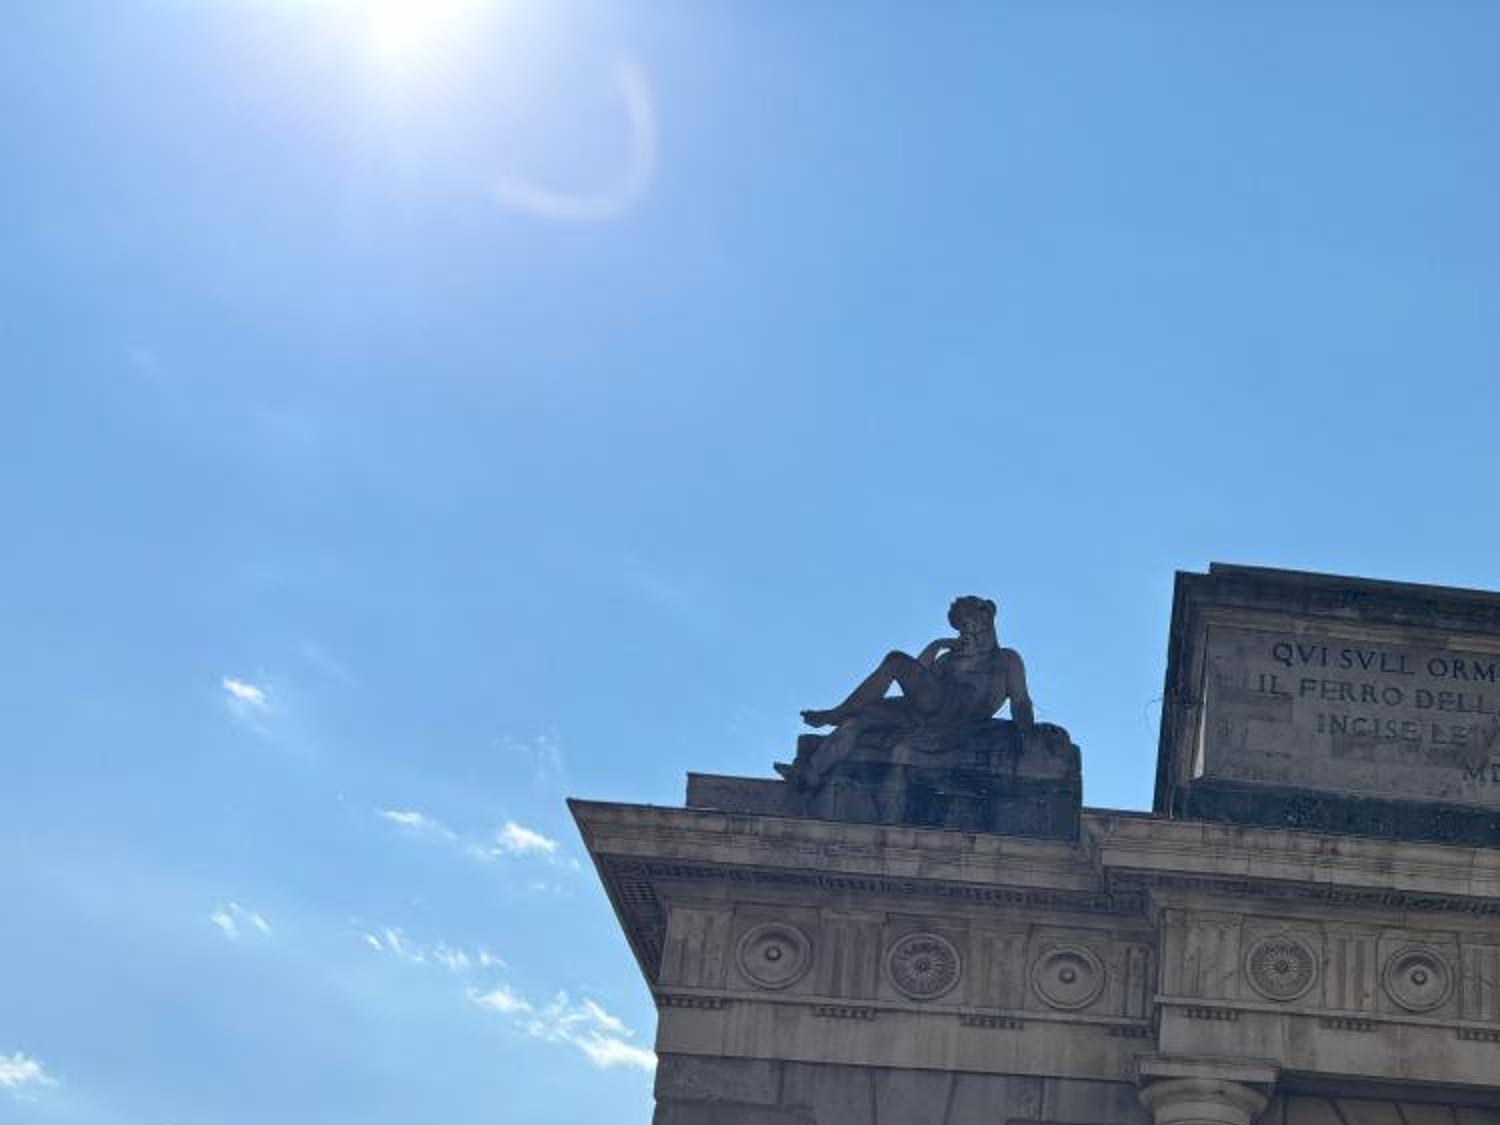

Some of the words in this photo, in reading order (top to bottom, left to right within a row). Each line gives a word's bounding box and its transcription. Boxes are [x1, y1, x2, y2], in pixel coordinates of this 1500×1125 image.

[1273, 642, 1327, 667] QVI
[1340, 649, 1415, 675] SVLL
[1259, 673, 1290, 696] IL
[1300, 678, 1403, 707] FERRO
[1317, 713, 1418, 742] INCISE
